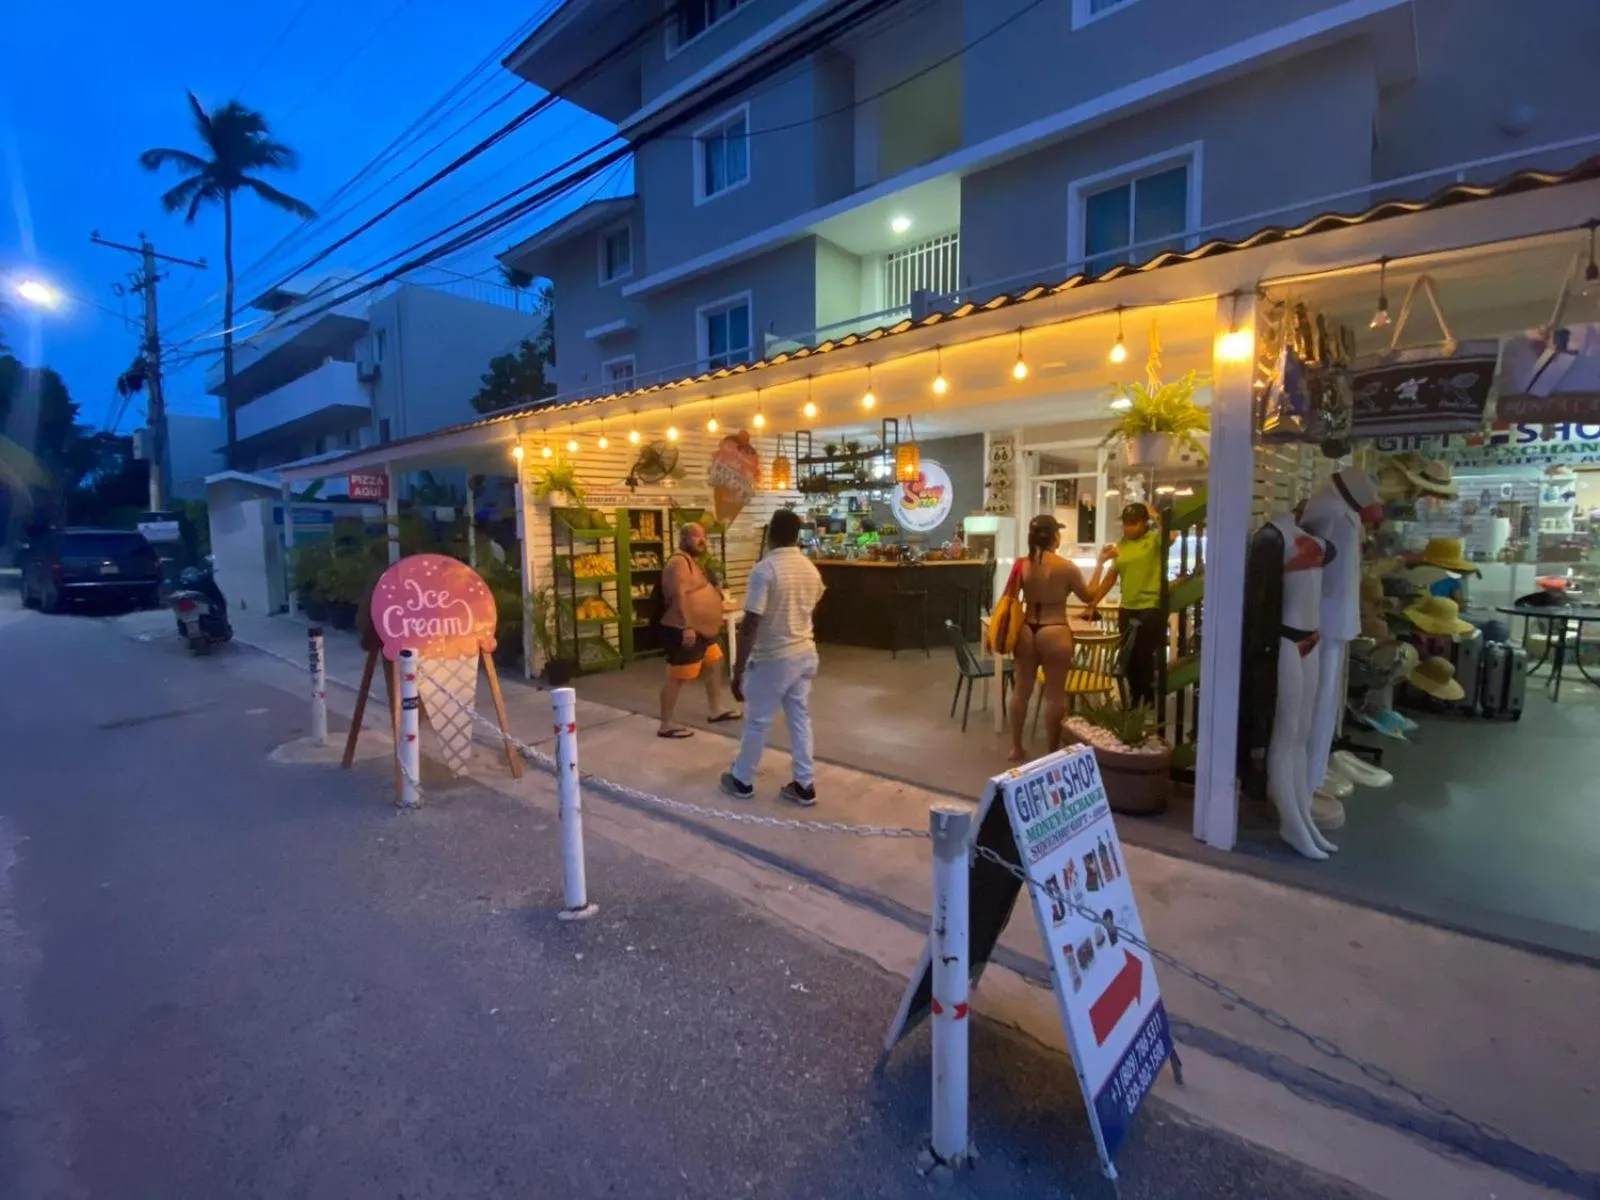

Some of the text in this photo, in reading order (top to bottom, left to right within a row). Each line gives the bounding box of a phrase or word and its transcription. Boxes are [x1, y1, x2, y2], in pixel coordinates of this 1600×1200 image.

[404, 579, 450, 611] Ice
[383, 599, 473, 638] Cream
[1014, 754, 1096, 823] GIFT SHOP
[1025, 811, 1061, 842] MONEY
